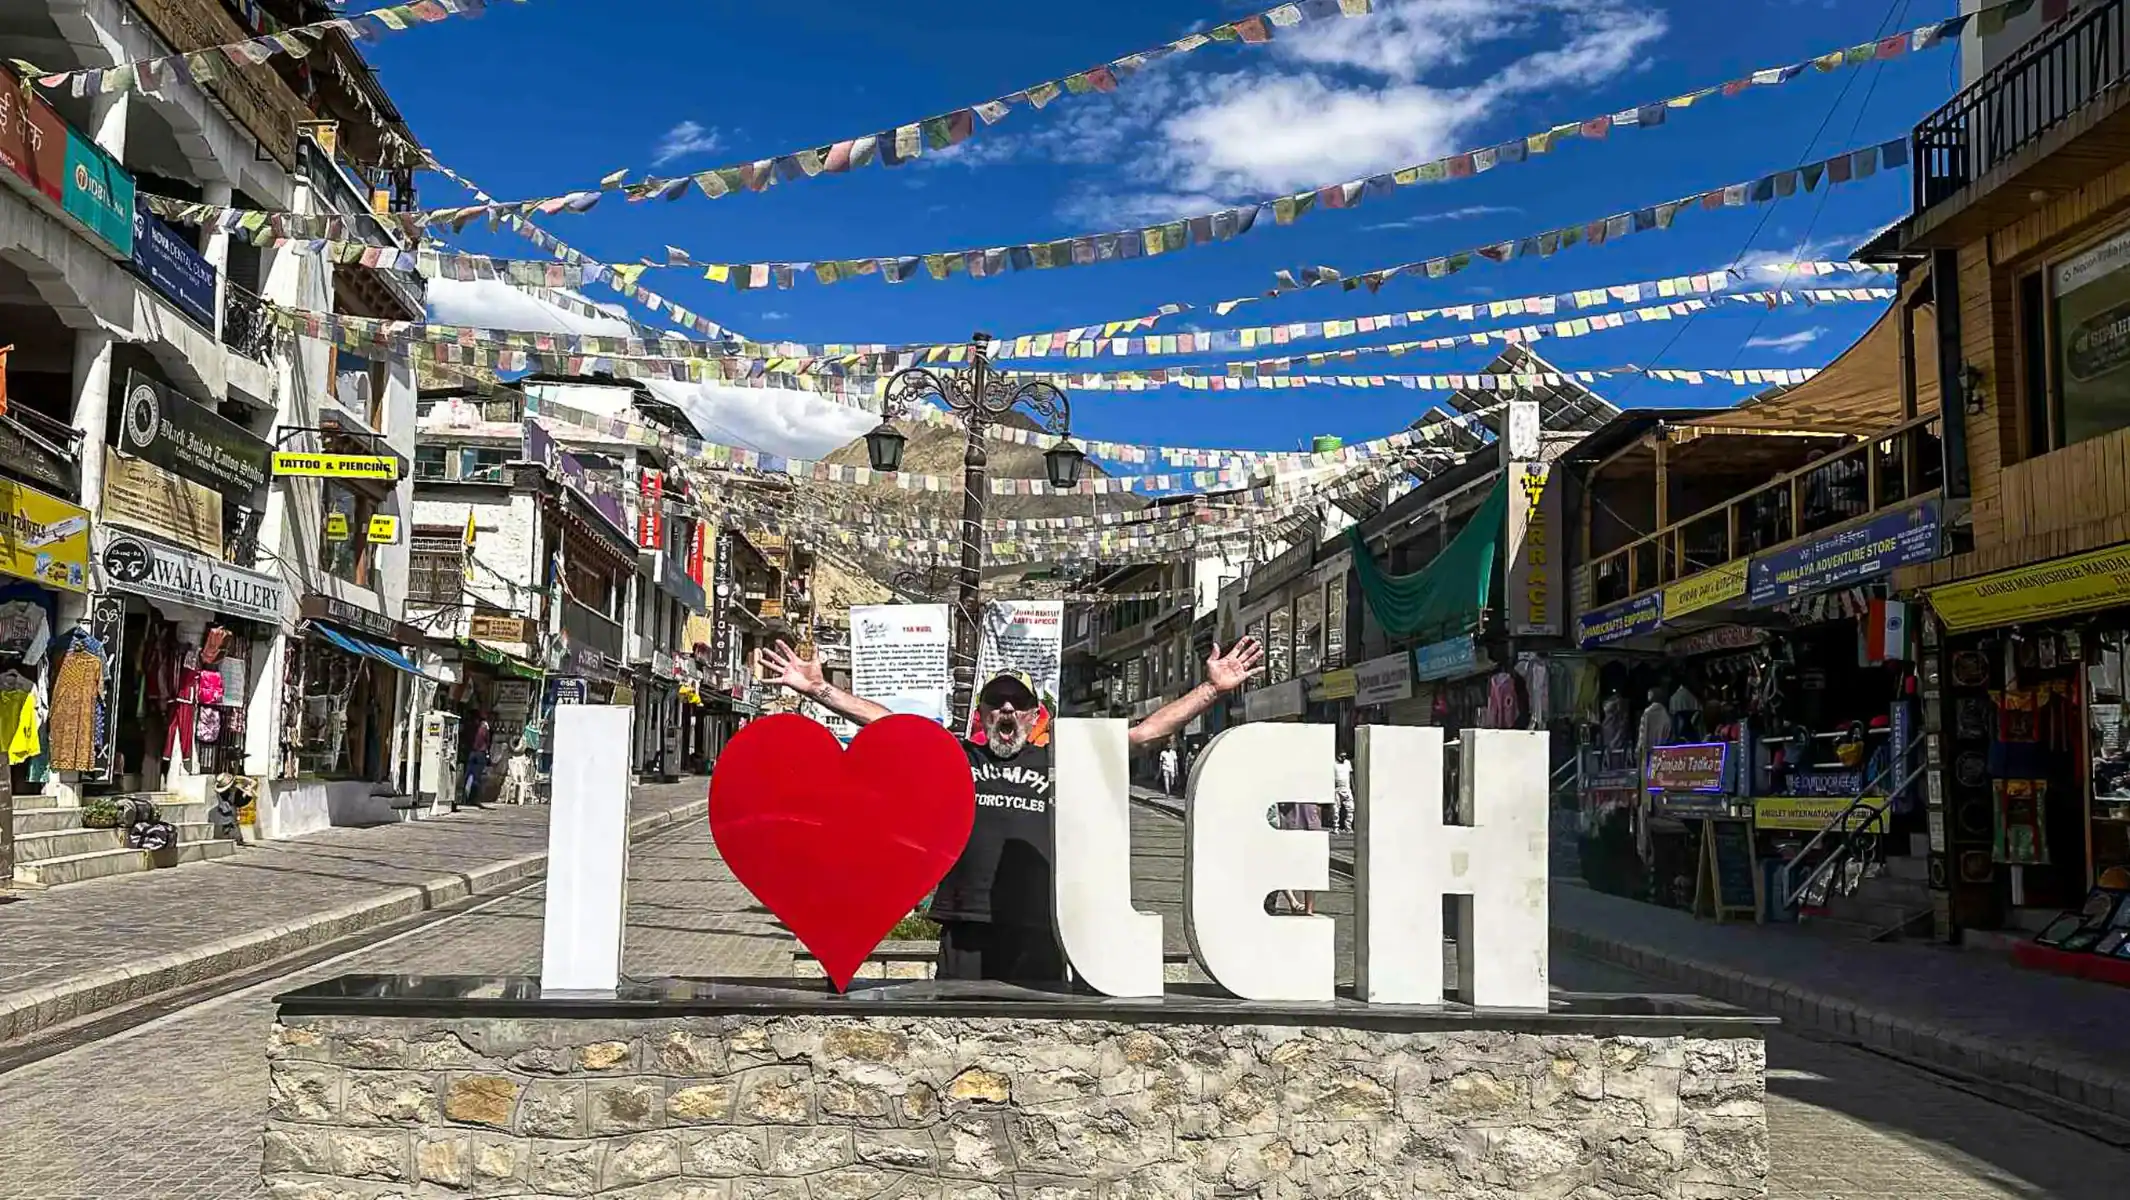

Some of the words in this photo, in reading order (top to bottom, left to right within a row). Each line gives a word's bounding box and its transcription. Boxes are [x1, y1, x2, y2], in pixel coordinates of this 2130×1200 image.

[152, 226, 170, 252] NOVA
[170, 242, 192, 272] DENTAL
[193, 262, 213, 287] CLINIC
[160, 418, 186, 446] Black
[187, 432, 213, 459] Inked
[213, 446, 239, 471] Tattoo
[239, 459, 265, 484] Studio
[279, 459, 320, 469] TATTOO
[326, 462, 334, 470] &
[339, 461, 392, 473] PIERCING
[1522, 474, 1549, 486] THE
[11, 513, 46, 539] TRAVELS
[1526, 486, 1548, 624] TERRACE
[1775, 563, 1815, 585] HIMALAYA
[1816, 548, 1866, 574] ADVENTURE
[1866, 537, 1897, 559] STORE
[210, 574, 282, 612] GALLERY
[1975, 580, 2016, 598] LADAKH
[2014, 565, 2084, 588] MANJUSHREE
[716, 598, 727, 659] Travel
[557, 697, 580, 705] ATM
[970, 762, 1050, 795] RIUMPH
[974, 793, 1045, 813] TORCYCLES
[541, 703, 632, 997] I
[1053, 716, 1551, 1011] LEH
